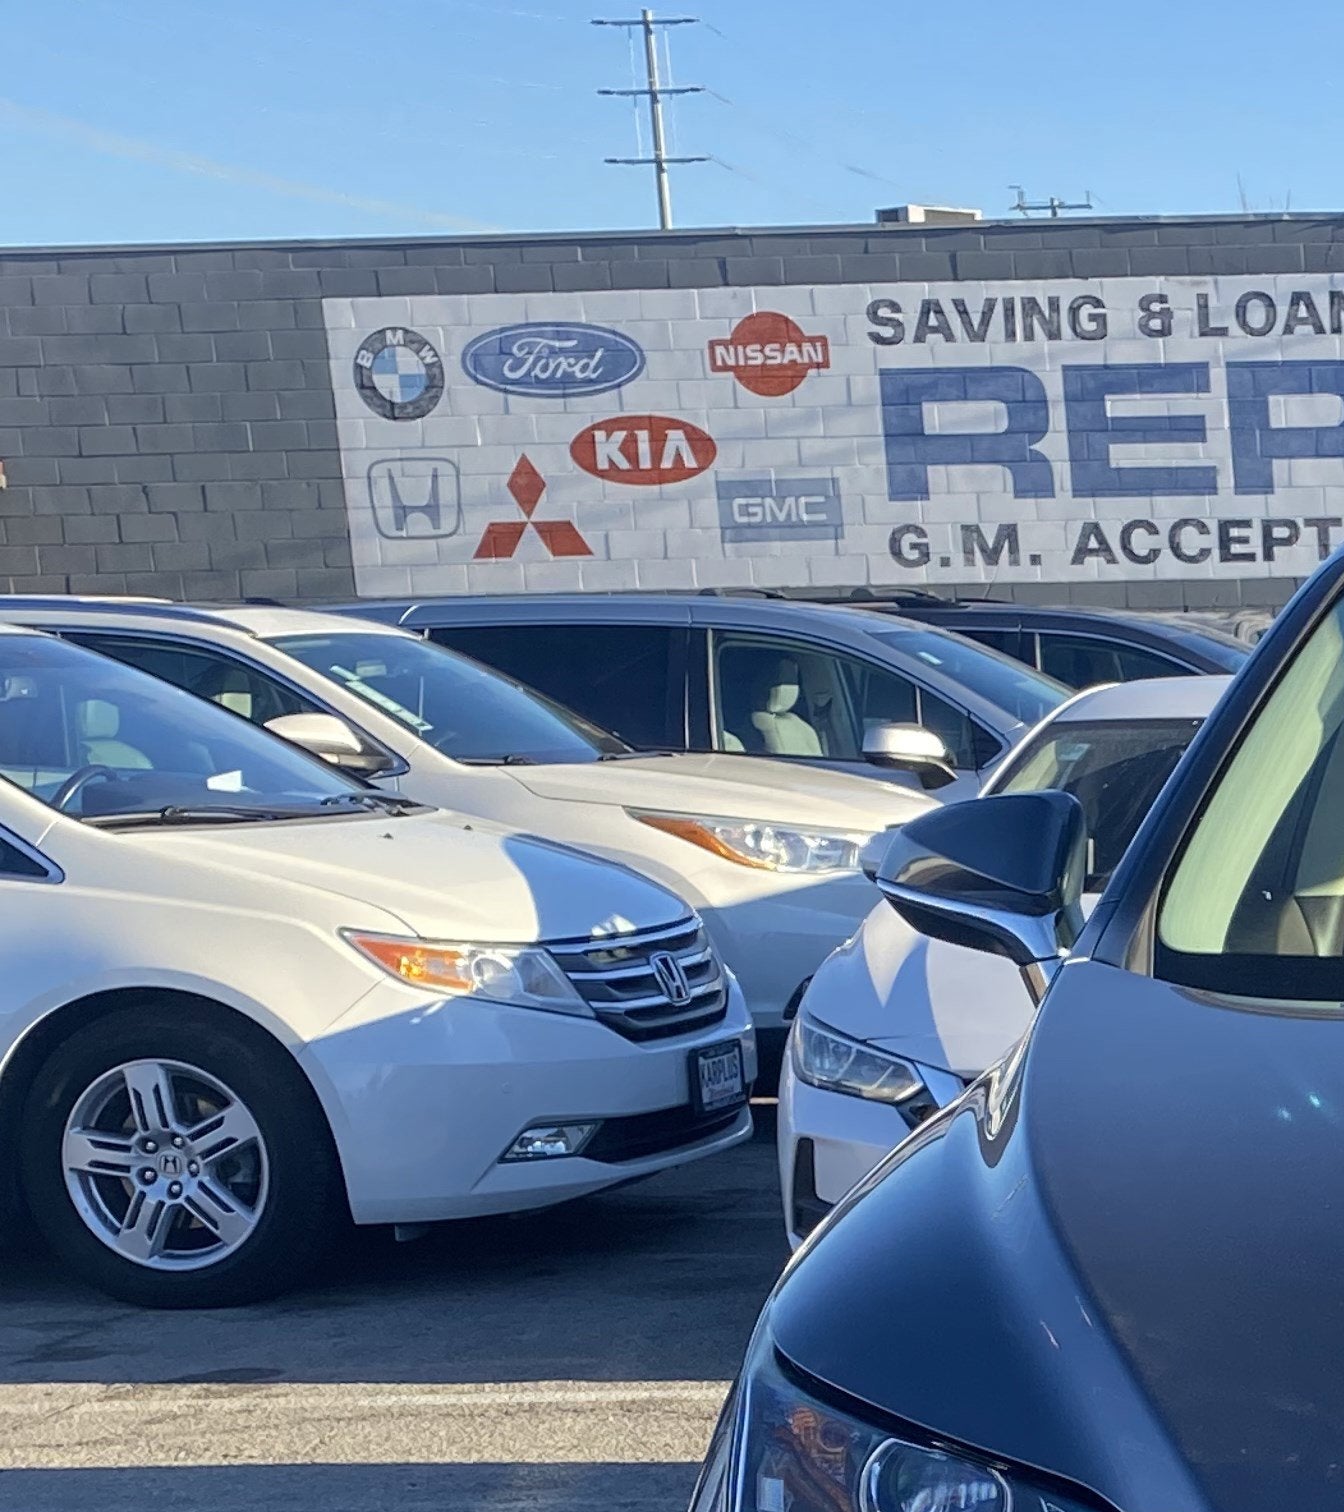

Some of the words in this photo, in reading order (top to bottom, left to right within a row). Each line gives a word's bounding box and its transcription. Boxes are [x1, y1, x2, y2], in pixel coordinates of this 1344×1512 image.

[866, 294, 1107, 346] SAVING
[1138, 292, 1174, 338] &
[502, 338, 602, 380] Ford
[715, 345, 823, 368] NISSAN
[593, 430, 697, 470] KIA
[732, 497, 827, 524] GMC
[888, 522, 1042, 568] G.M.
